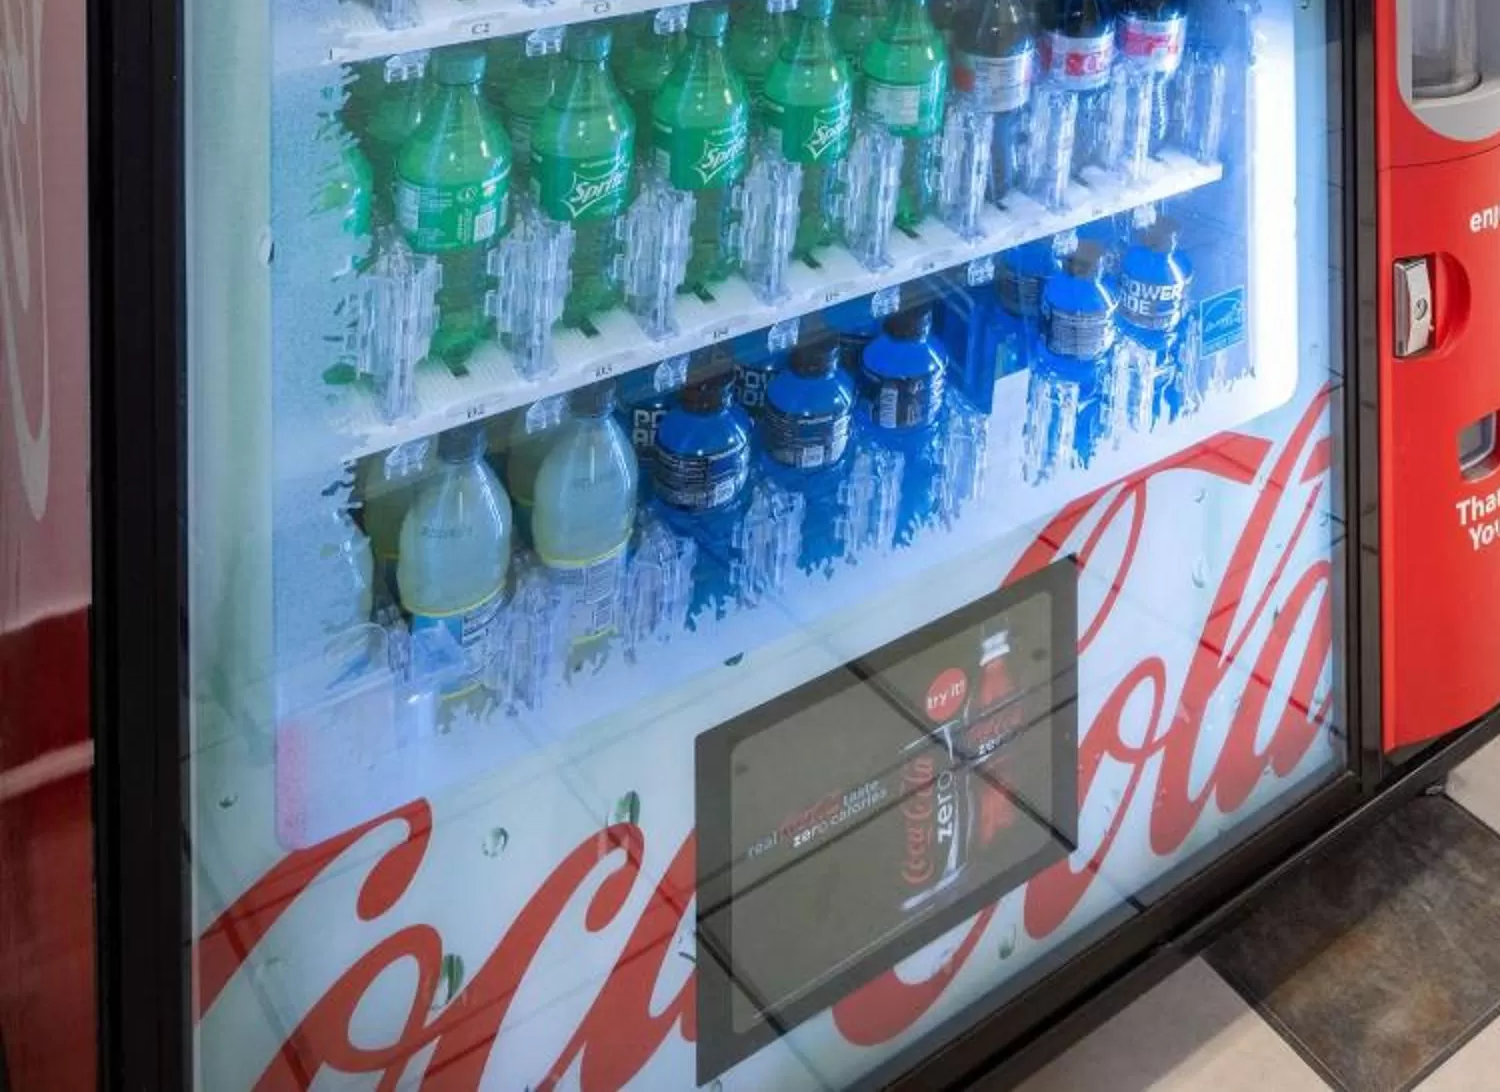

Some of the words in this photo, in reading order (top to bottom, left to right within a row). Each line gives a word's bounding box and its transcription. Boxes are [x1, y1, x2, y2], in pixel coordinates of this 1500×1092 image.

[471, 22, 490, 35] C2
[593, 1, 611, 14] C3
[936, 769, 954, 845] zero
[747, 830, 778, 858] real
